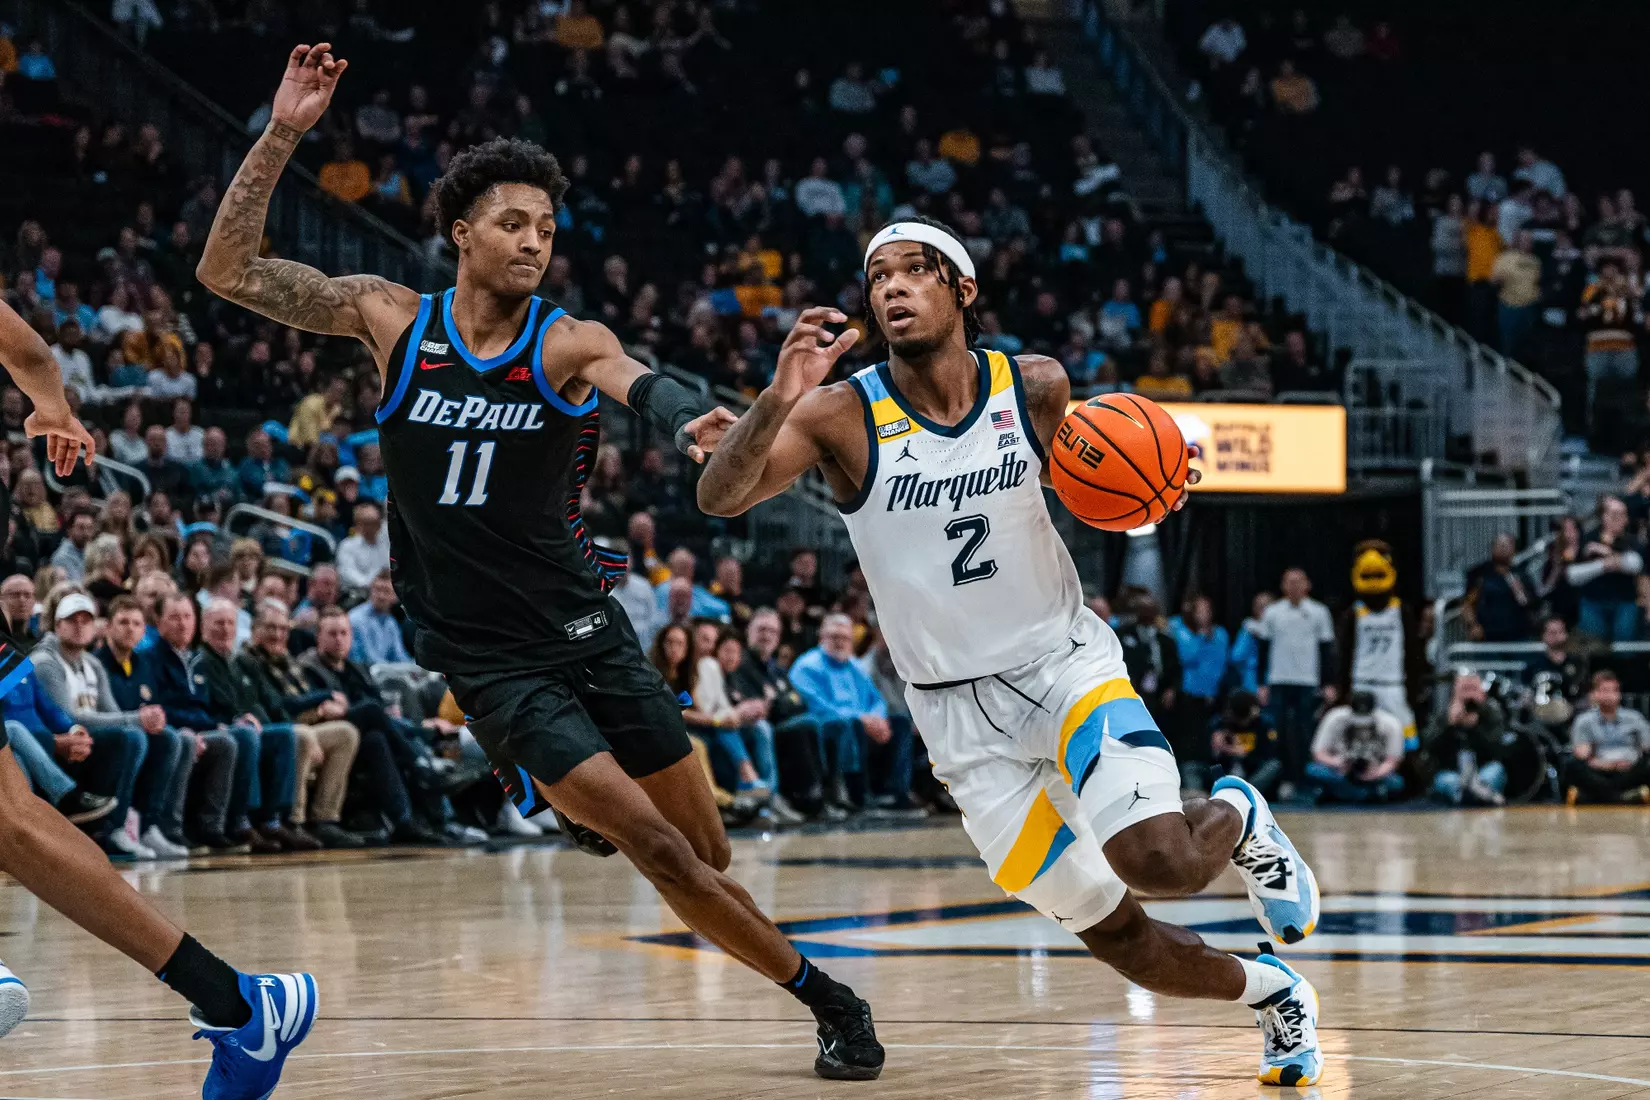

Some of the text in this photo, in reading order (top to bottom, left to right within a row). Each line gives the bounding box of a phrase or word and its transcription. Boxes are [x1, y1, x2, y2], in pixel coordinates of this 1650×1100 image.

[420, 345, 448, 355] CHANGE
[880, 424, 910, 438] CHANGE
[997, 437, 1020, 446] EAST
[999, 431, 1015, 440] BIG
[1056, 421, 1106, 470] ELITE
[436, 439, 497, 506] 11
[885, 452, 1028, 512] Marquette
[944, 513, 999, 587] 2
